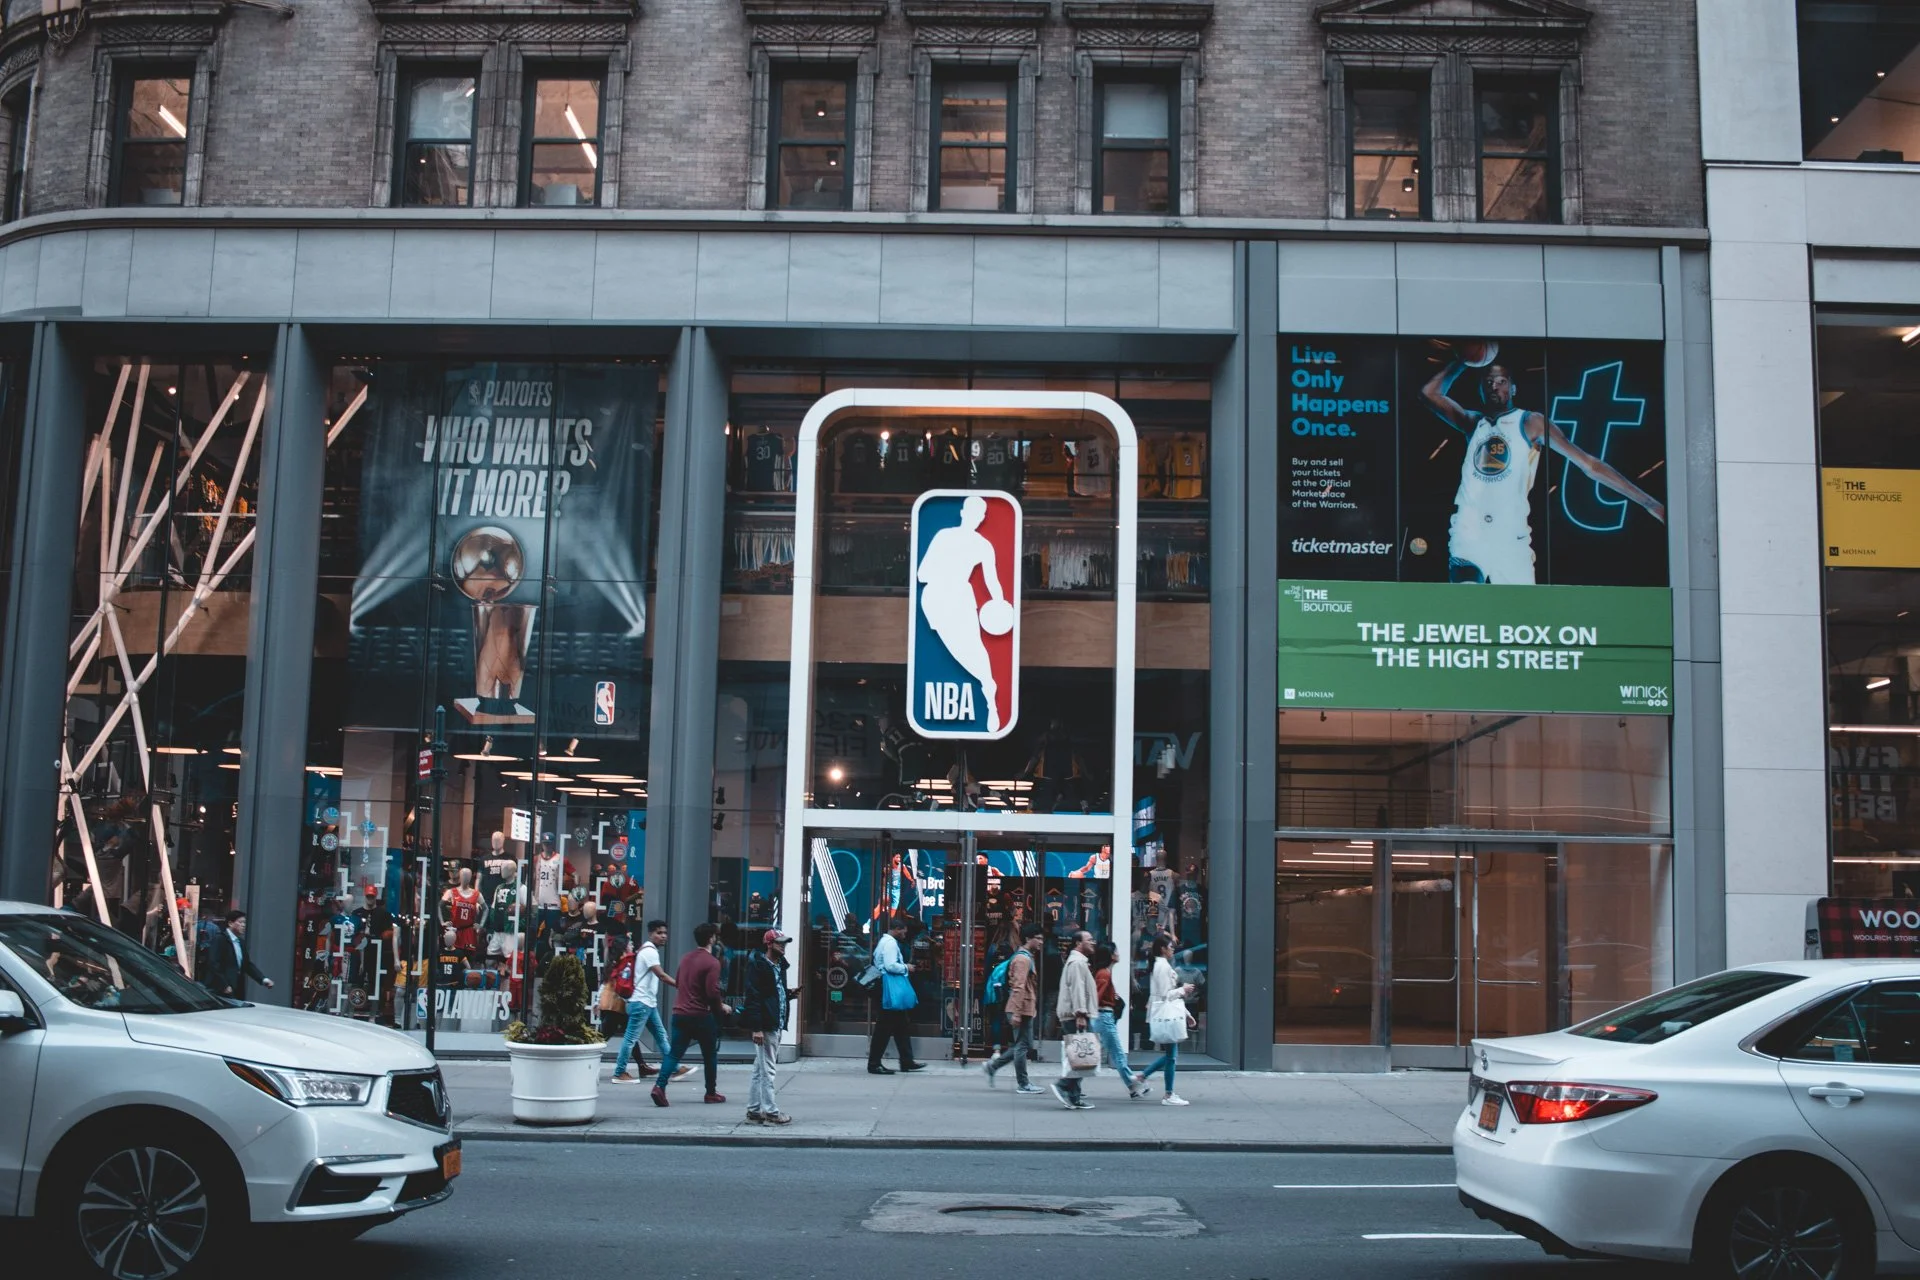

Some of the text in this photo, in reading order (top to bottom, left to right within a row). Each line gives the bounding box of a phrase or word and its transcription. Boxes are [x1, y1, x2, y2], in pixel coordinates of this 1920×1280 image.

[1292, 345, 1337, 364] Live
[1292, 369, 1344, 393] Only
[483, 380, 553, 407] PLAYOFFS
[1292, 394, 1389, 417] Happens
[1292, 417, 1357, 437] Once.
[423, 415, 593, 466] WHO WANTS
[1490, 444, 1505, 455] 35
[1292, 458, 1344, 467] Buy and sell
[1313, 469, 1341, 477] tickets
[1303, 479, 1317, 487] the
[1320, 479, 1351, 488] Official
[1845, 481, 1866, 491] THE
[470, 469, 571, 518] MORE?
[1292, 490, 1345, 499] Marketplace
[1845, 493, 1902, 503] TOWNHOUSE
[1292, 500, 1358, 509] of the Warriors.
[1291, 538, 1393, 555] ticketmaster
[1842, 548, 1877, 556] MOINIAN
[1304, 589, 1328, 600] THE
[1304, 602, 1353, 613] BOUTIQUE
[1357, 622, 1598, 646] THE JEWEL BOX ON
[1372, 647, 1584, 670] THE HIGH STREET
[924, 681, 976, 721] NBA
[460, 908, 469, 920] 13
[435, 988, 512, 1021] PLAYOFFS
